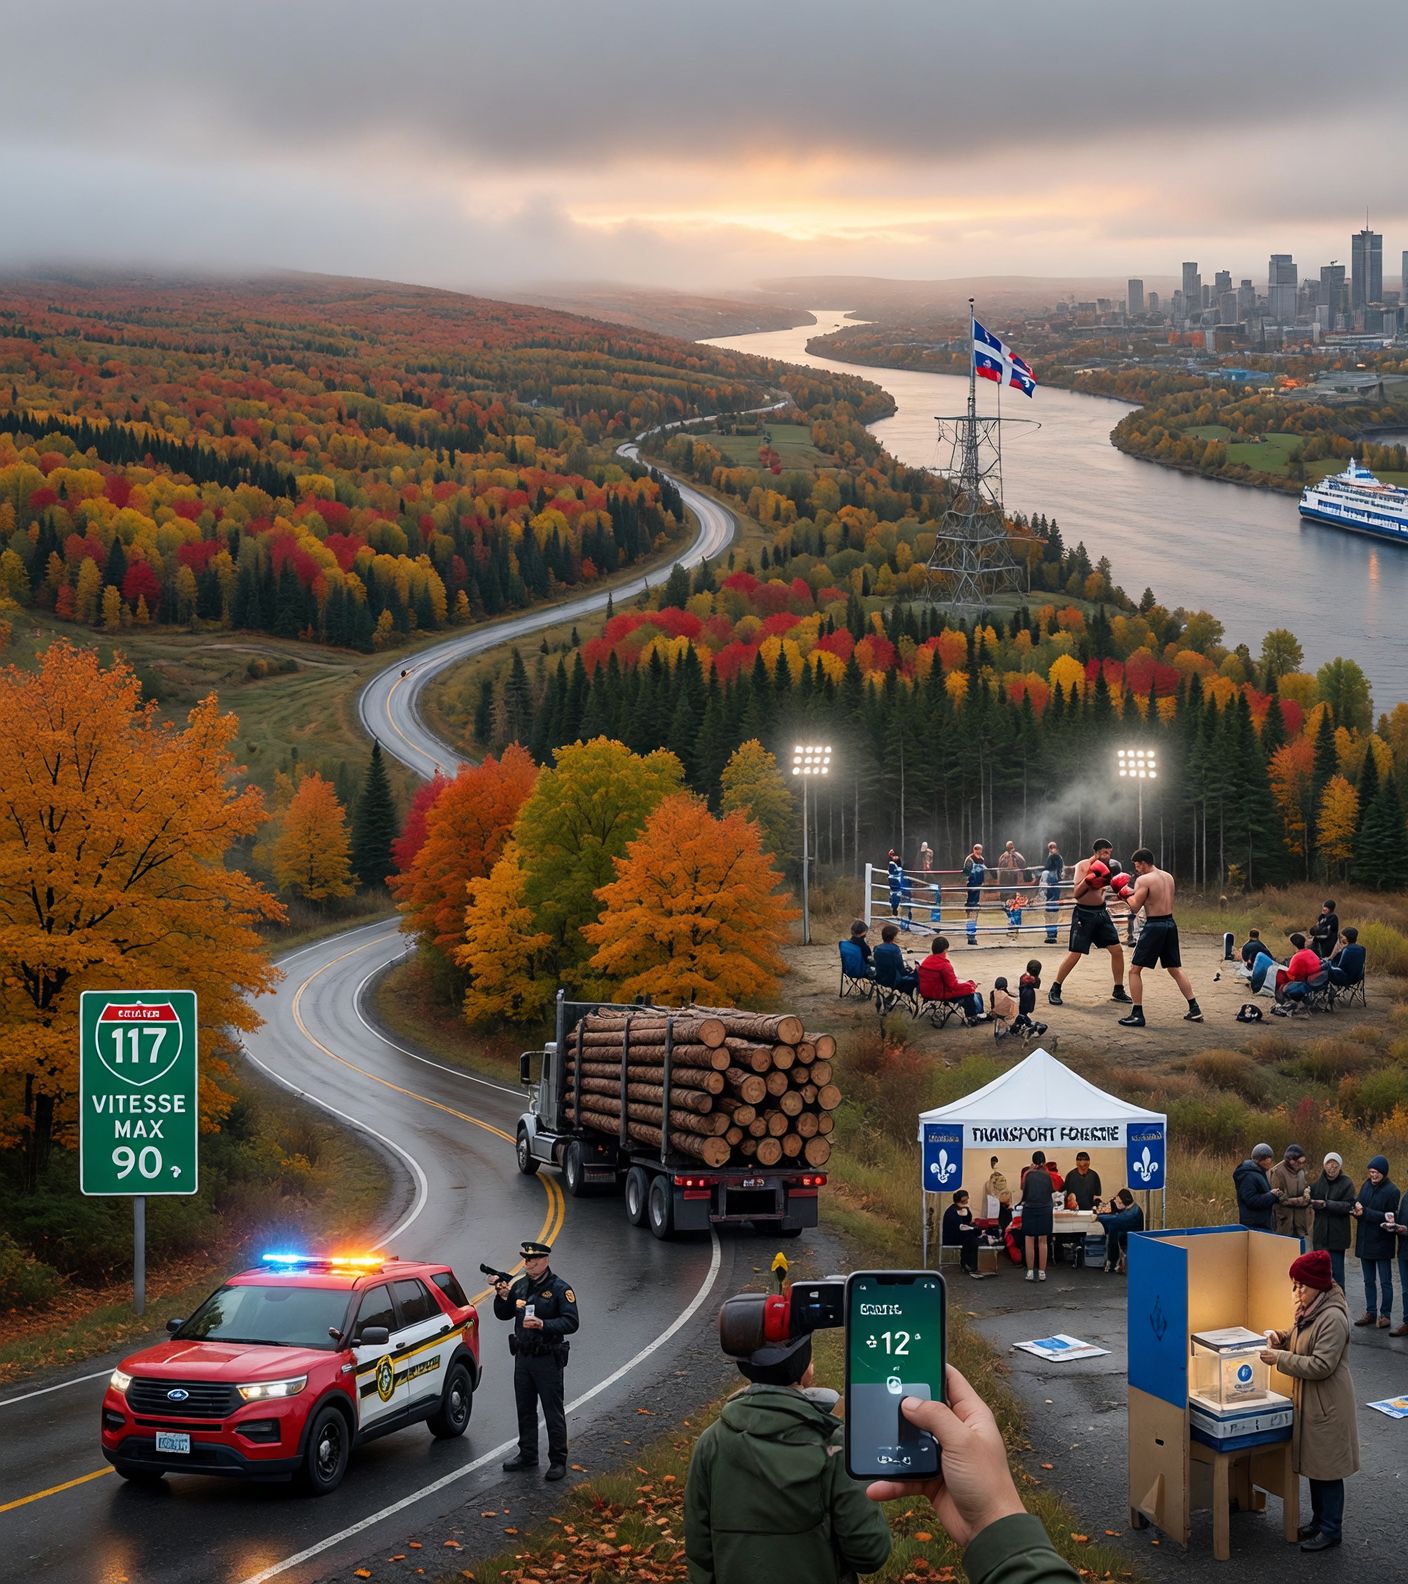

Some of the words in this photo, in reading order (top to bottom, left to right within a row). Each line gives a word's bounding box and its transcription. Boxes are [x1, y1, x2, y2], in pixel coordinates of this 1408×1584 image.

[111, 1027, 167, 1064] 117
[92, 1094, 186, 1114] VITESSE
[114, 1119, 164, 1139] MAX
[111, 1145, 163, 1180] 90
